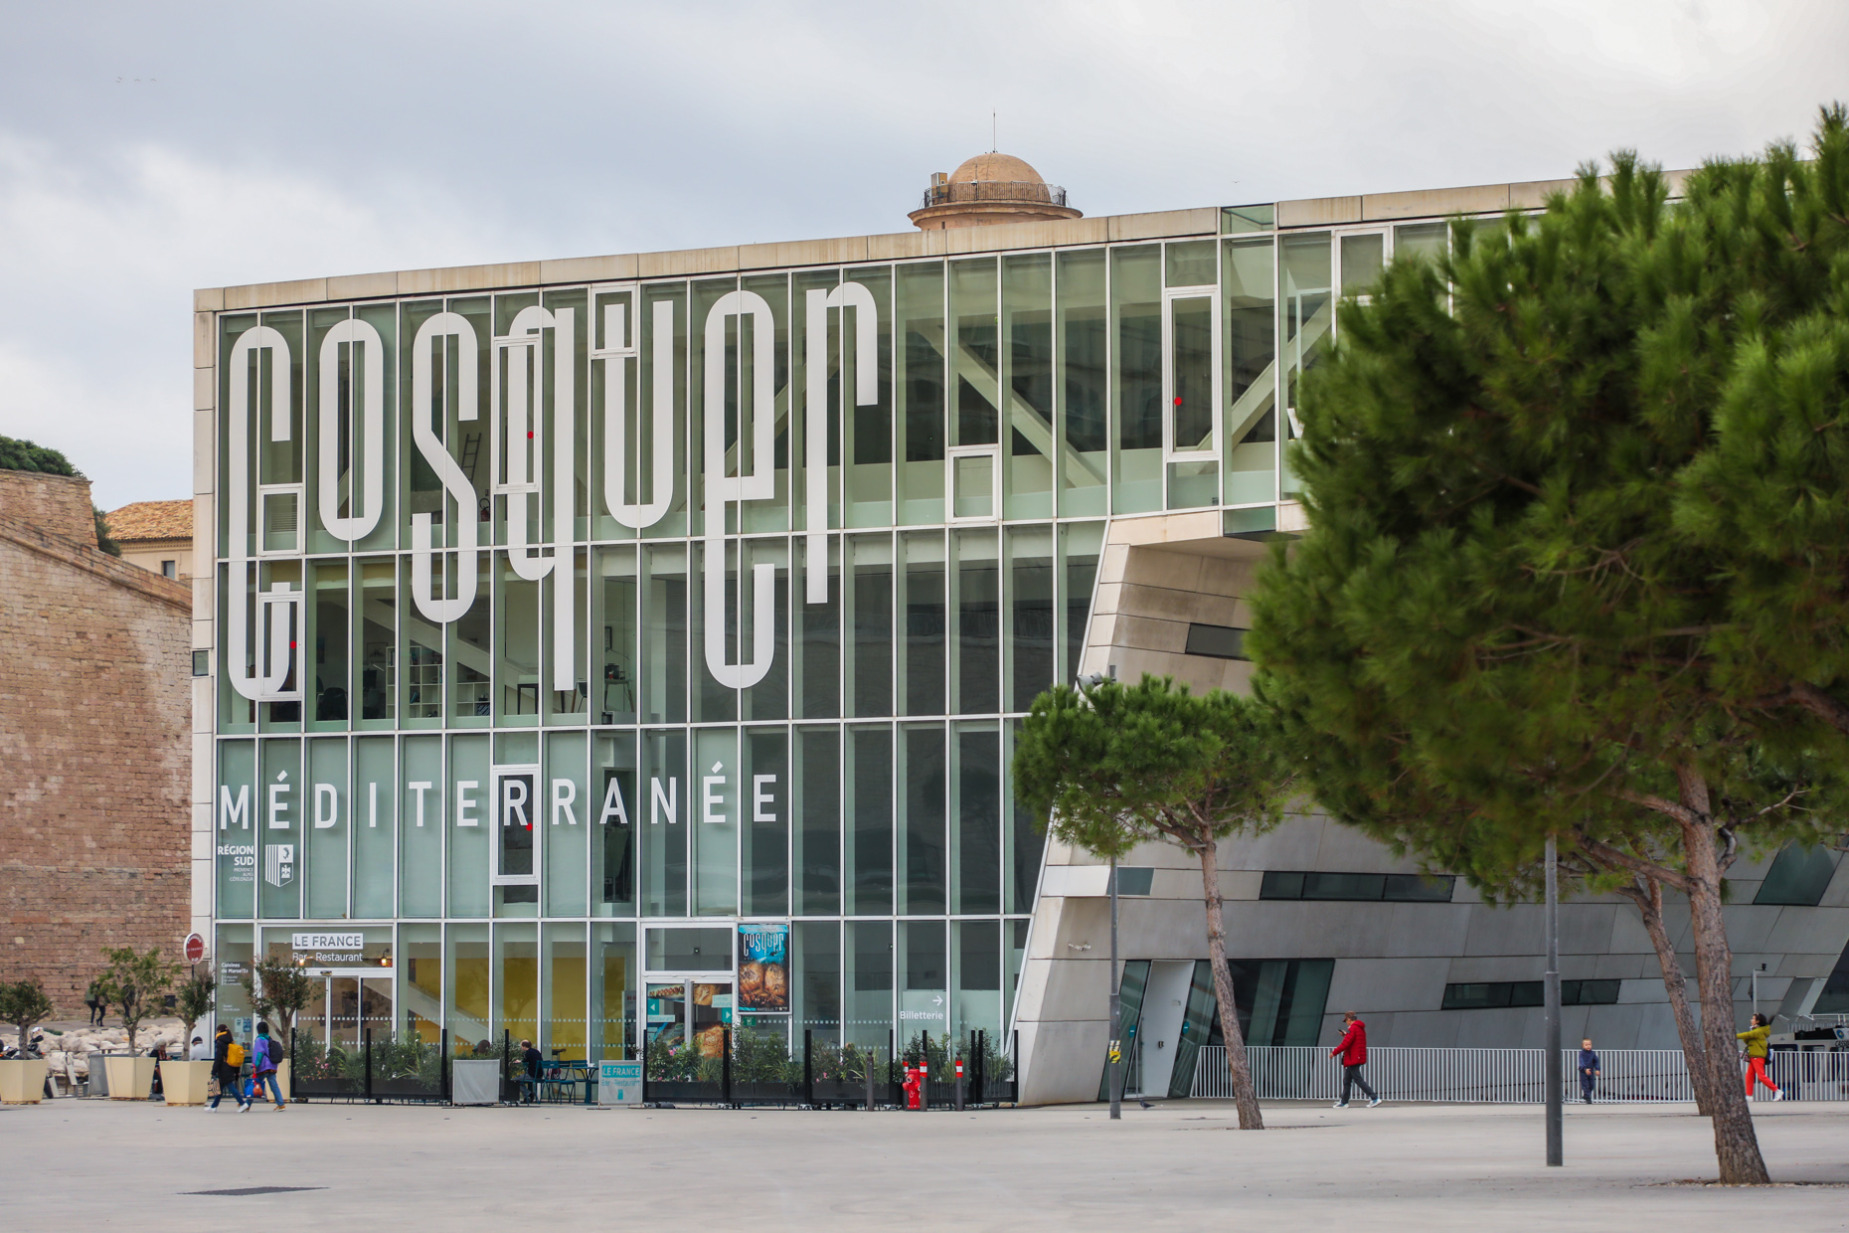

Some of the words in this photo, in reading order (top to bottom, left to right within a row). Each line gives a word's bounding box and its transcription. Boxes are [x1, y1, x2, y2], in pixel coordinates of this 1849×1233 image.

[220, 760, 777, 830] MÉDITERRANÉE
[217, 844, 254, 855] RÉGION
[234, 856, 254, 866] SUD
[294, 935, 309, 947] LE
[312, 935, 361, 947] FRANCE
[292, 952, 307, 962] Bar
[315, 952, 363, 962] Restaurant
[899, 1010, 944, 1020] Billetterie
[603, 1067, 611, 1076] LE
[612, 1066, 641, 1076] FRANCE
